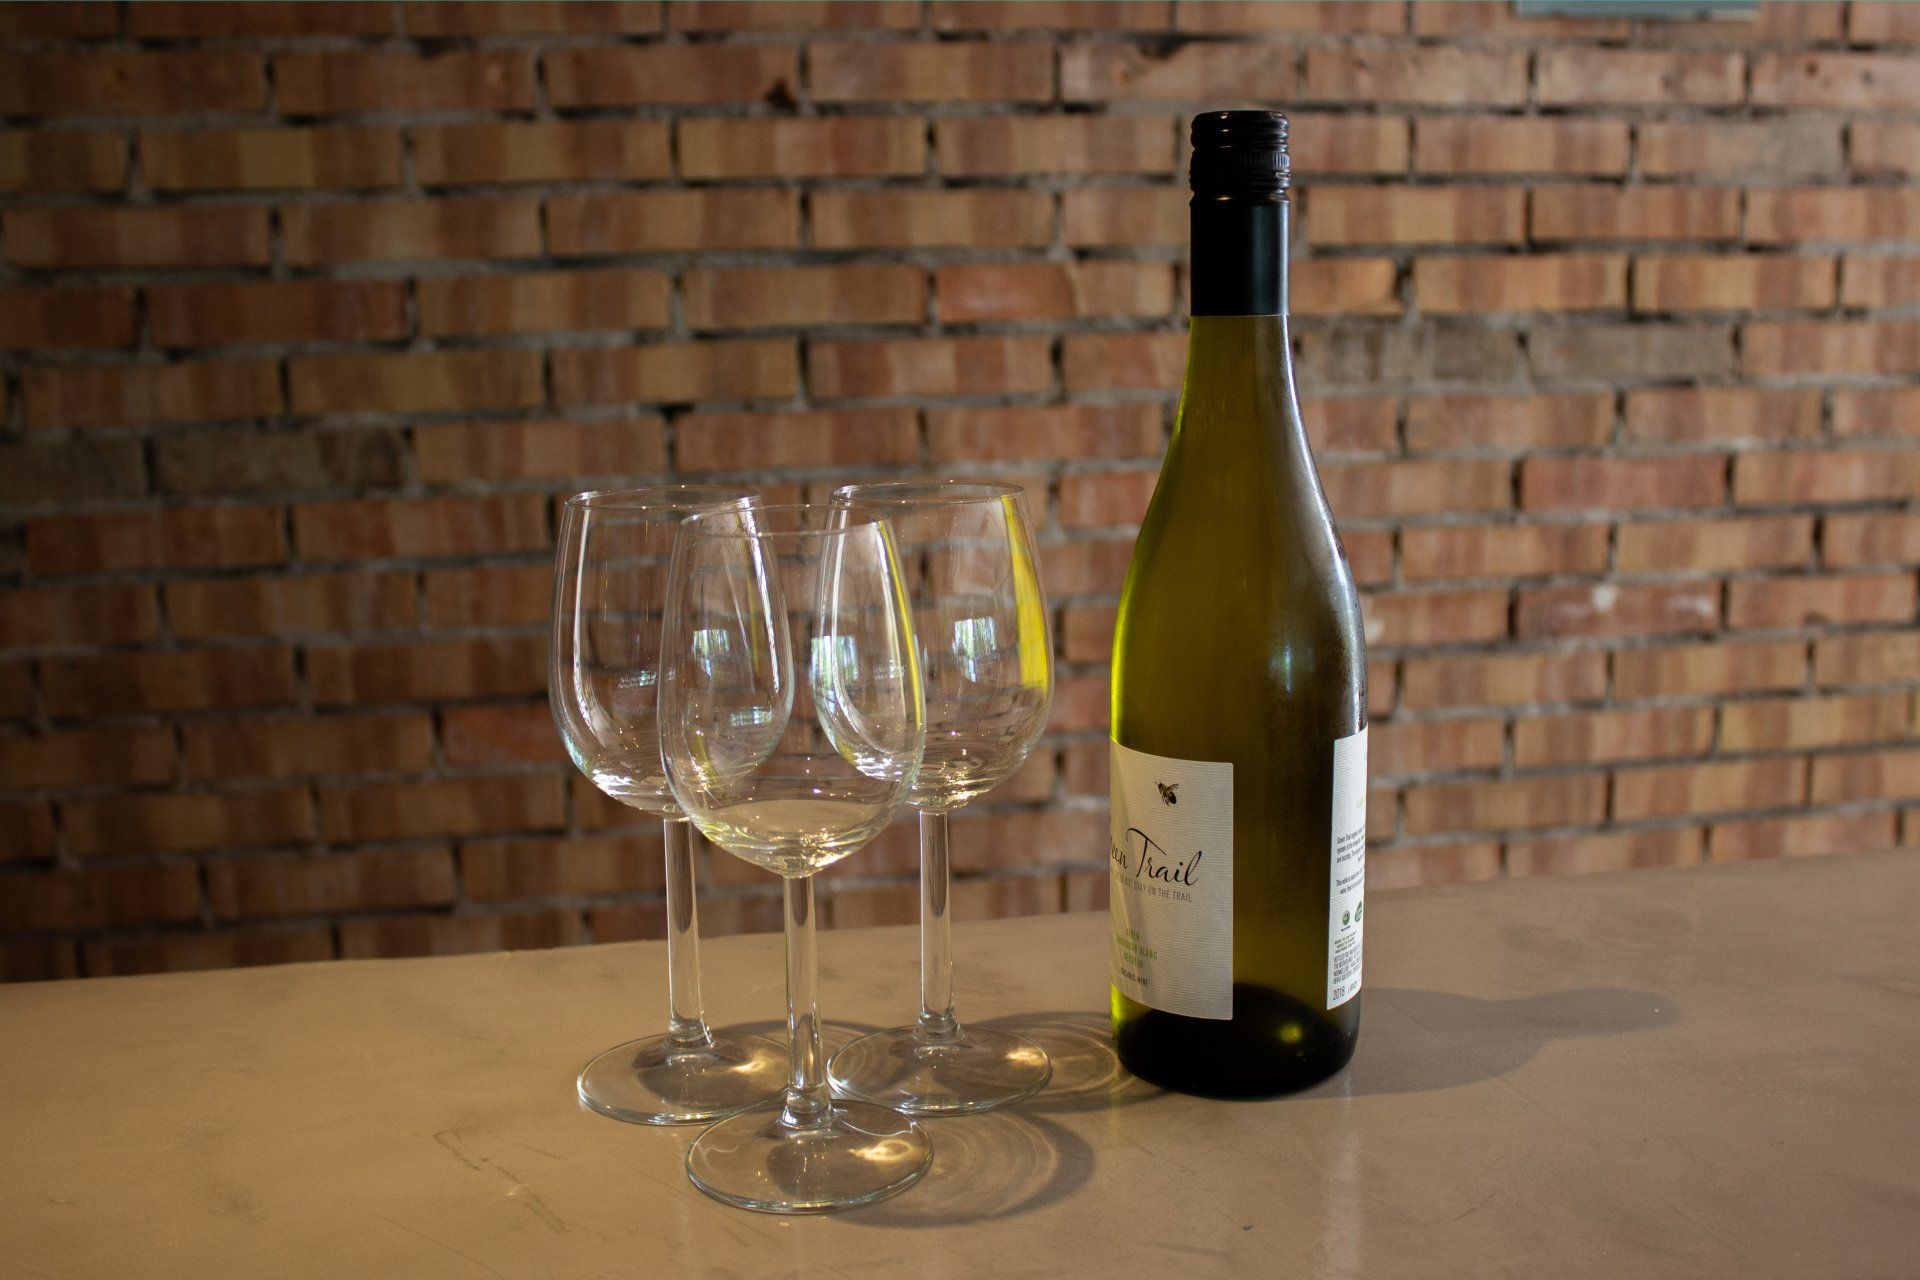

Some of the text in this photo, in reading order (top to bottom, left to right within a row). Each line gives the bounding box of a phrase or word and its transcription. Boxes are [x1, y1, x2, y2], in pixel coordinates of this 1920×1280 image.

[1111, 827, 1202, 886] een Trail
[1172, 890, 1192, 902] TRAIL
